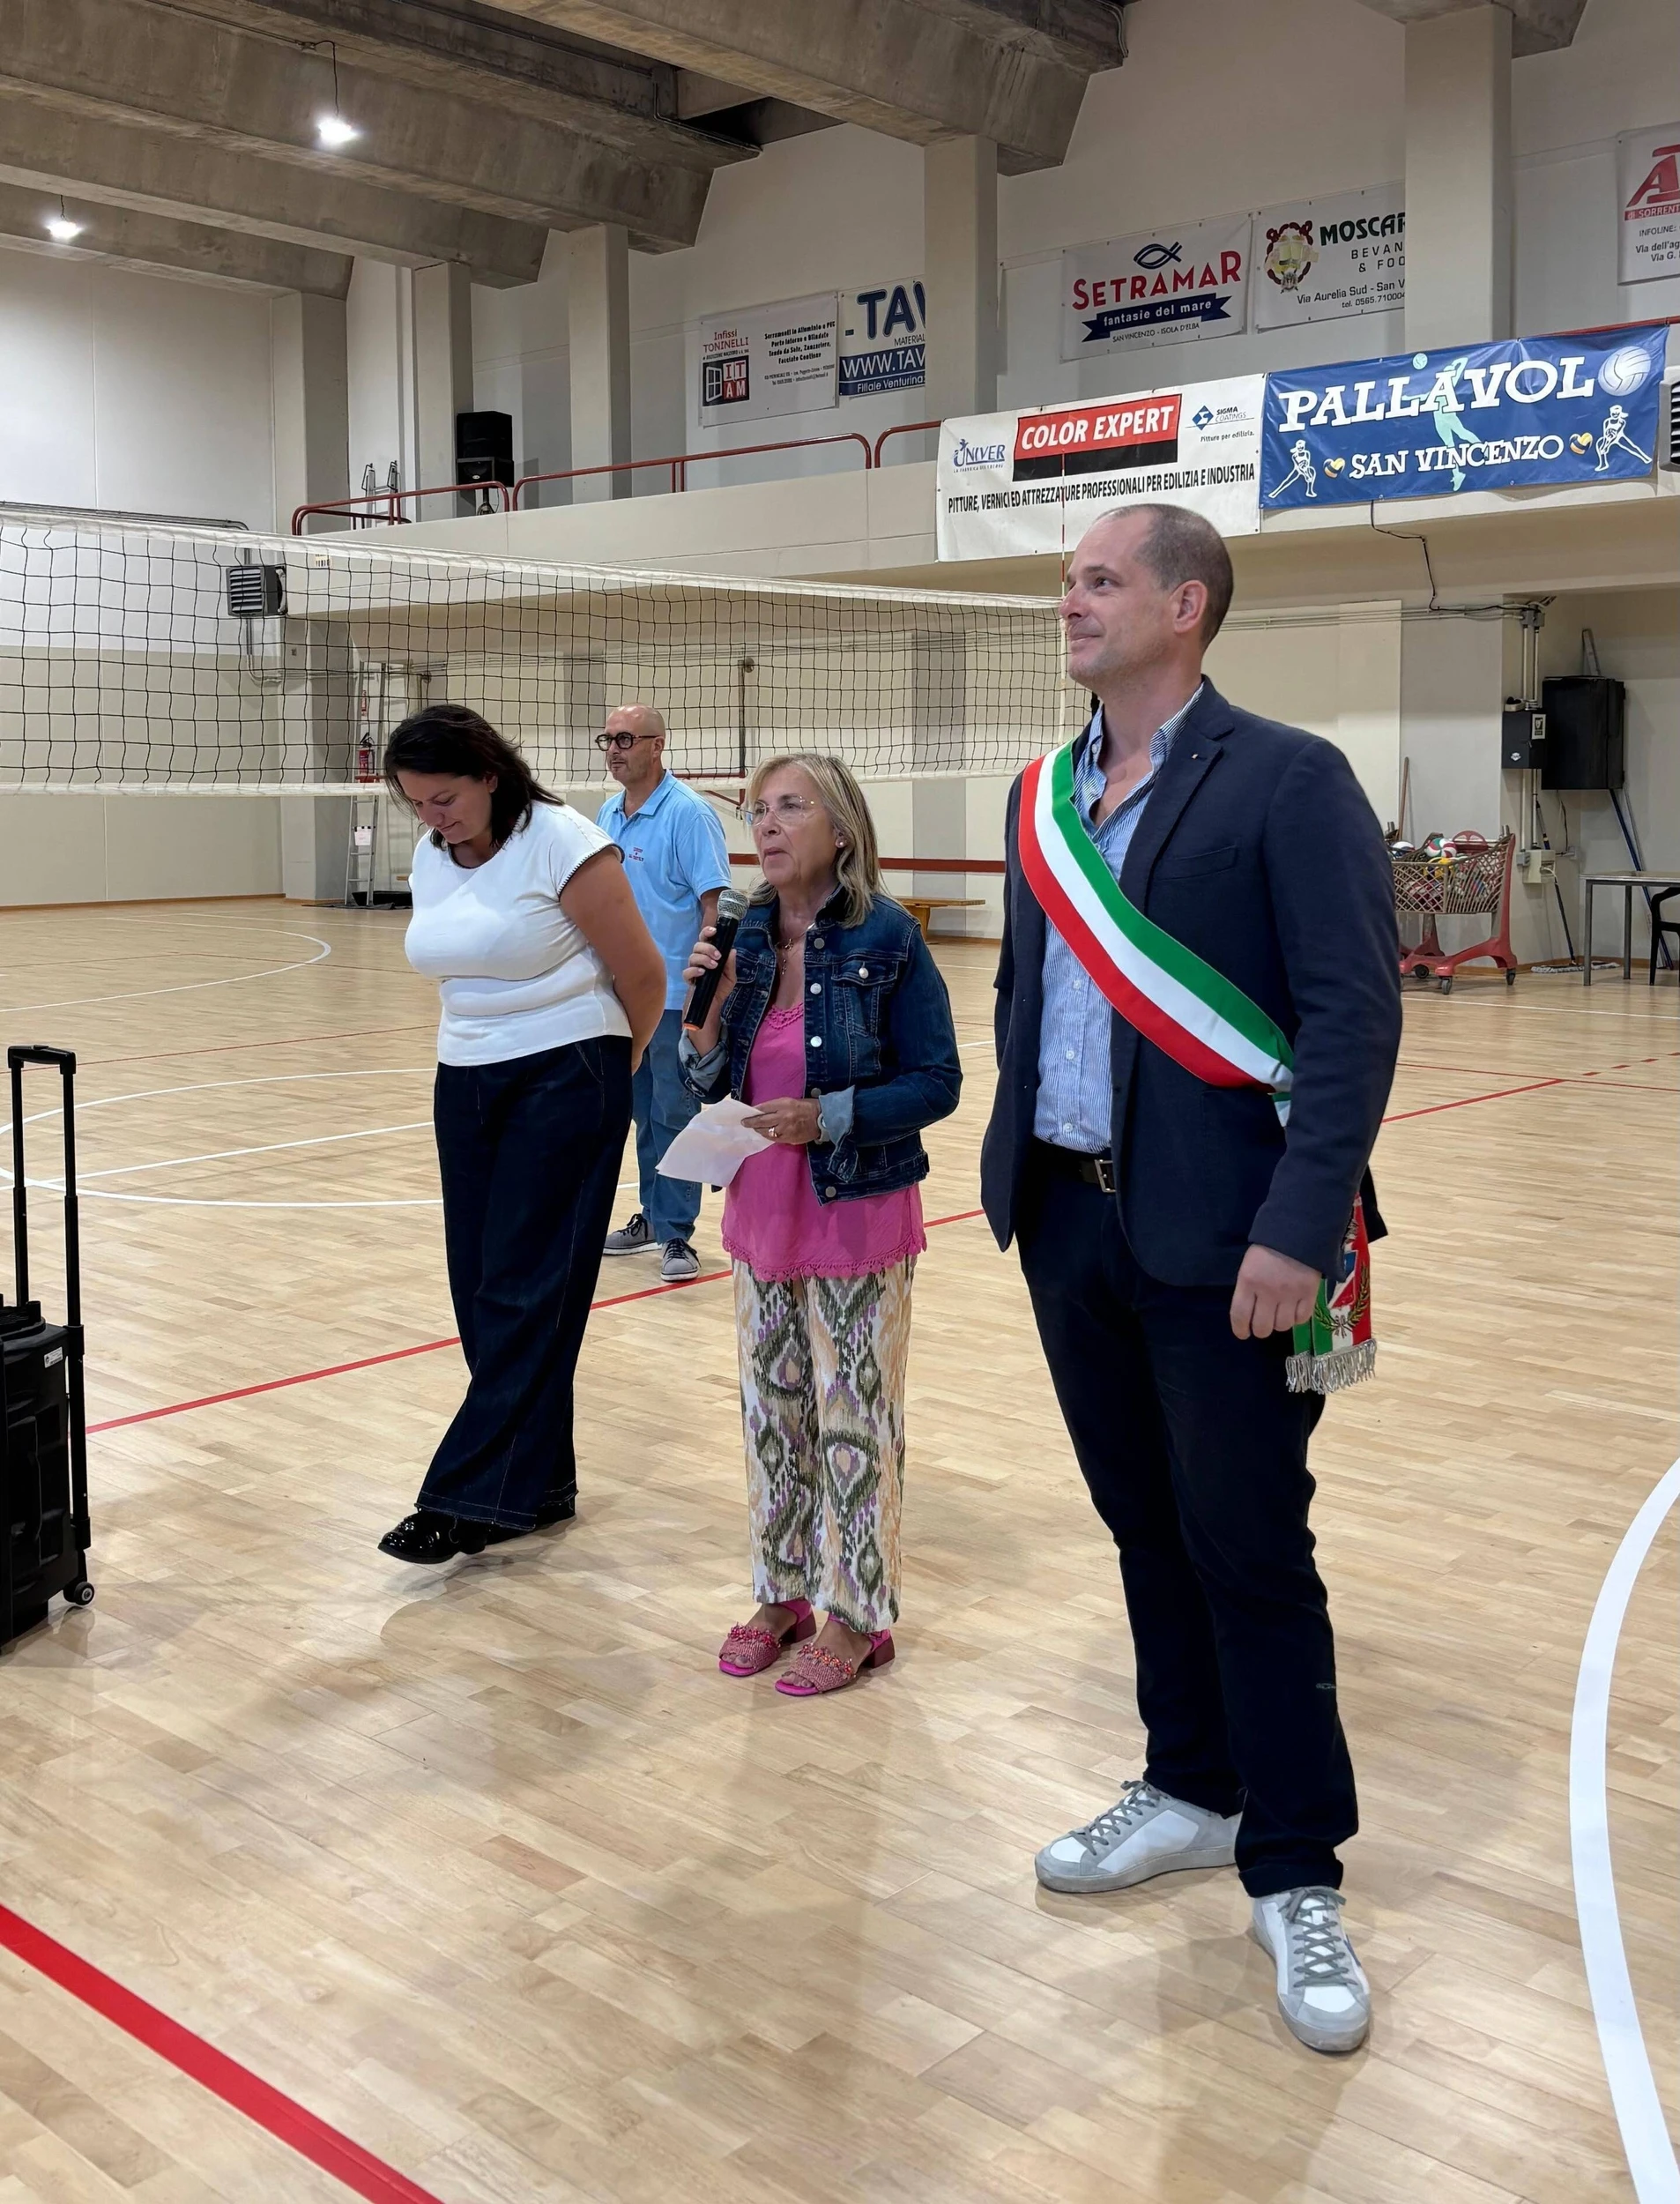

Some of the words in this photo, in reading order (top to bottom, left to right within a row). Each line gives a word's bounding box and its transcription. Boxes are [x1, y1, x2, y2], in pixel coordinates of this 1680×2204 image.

[1351, 242, 1403, 259] BEVAN
[1635, 244, 1649, 253] Via
[1651, 253, 1664, 262] Via
[1358, 263, 1366, 272] &
[1072, 250, 1241, 310] SETRAMAR
[1297, 294, 1311, 304] Via
[1314, 288, 1346, 302] Aurelia
[1349, 284, 1368, 296] Sud
[1376, 282, 1395, 292] San
[1103, 310, 1151, 327] fantasie
[1155, 304, 1175, 317] del
[1180, 301, 1212, 314] mare
[714, 329, 738, 341] Infissi
[1112, 334, 1124, 343] SAN
[1125, 329, 1155, 341] VINCENZO
[1160, 325, 1179, 335] ISOLA
[703, 337, 749, 353] TONINELLI
[857, 382, 881, 393] Filiale
[1215, 411, 1246, 422] COATINGS
[1217, 406, 1238, 416] SIGMA
[1022, 419, 1089, 450] COLOR
[1093, 405, 1175, 441] EXPERT
[953, 442, 1006, 467] UNIVER
[1349, 450, 1409, 479] SAN
[1415, 434, 1565, 472] VINCENZO
[948, 495, 980, 514] PITTURE,
[981, 491, 1011, 510] VERNICI
[1011, 491, 1021, 507] ED
[1022, 485, 1081, 506] ATTREZZATURE
[1082, 476, 1145, 499] PROFESSIONALI
[1147, 474, 1162, 492] PER
[1164, 469, 1199, 490] EDILIZIA
[1201, 469, 1206, 486] E
[1207, 463, 1255, 485] INDUSTRIA
